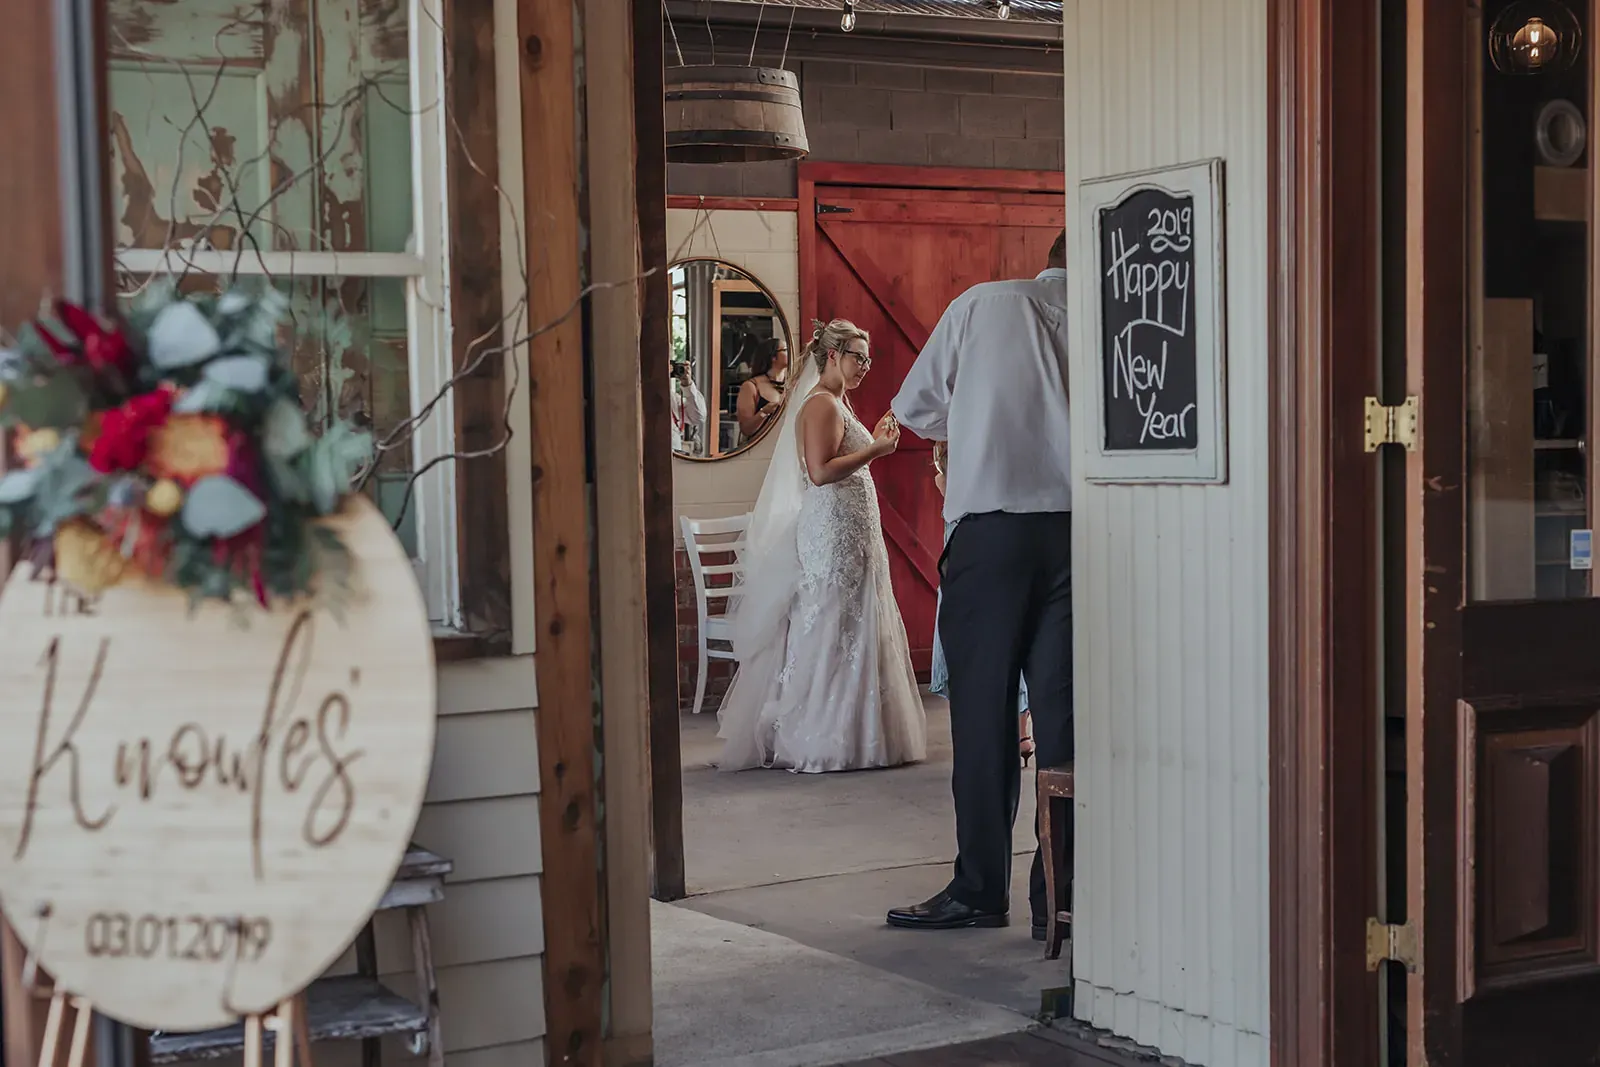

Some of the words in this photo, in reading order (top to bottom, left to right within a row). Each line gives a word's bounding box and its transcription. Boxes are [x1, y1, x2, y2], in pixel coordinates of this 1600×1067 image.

[1147, 207, 1192, 236] 2019
[1107, 227, 1190, 337] Happy
[1113, 322, 1168, 400] New
[1136, 392, 1196, 444] Year
